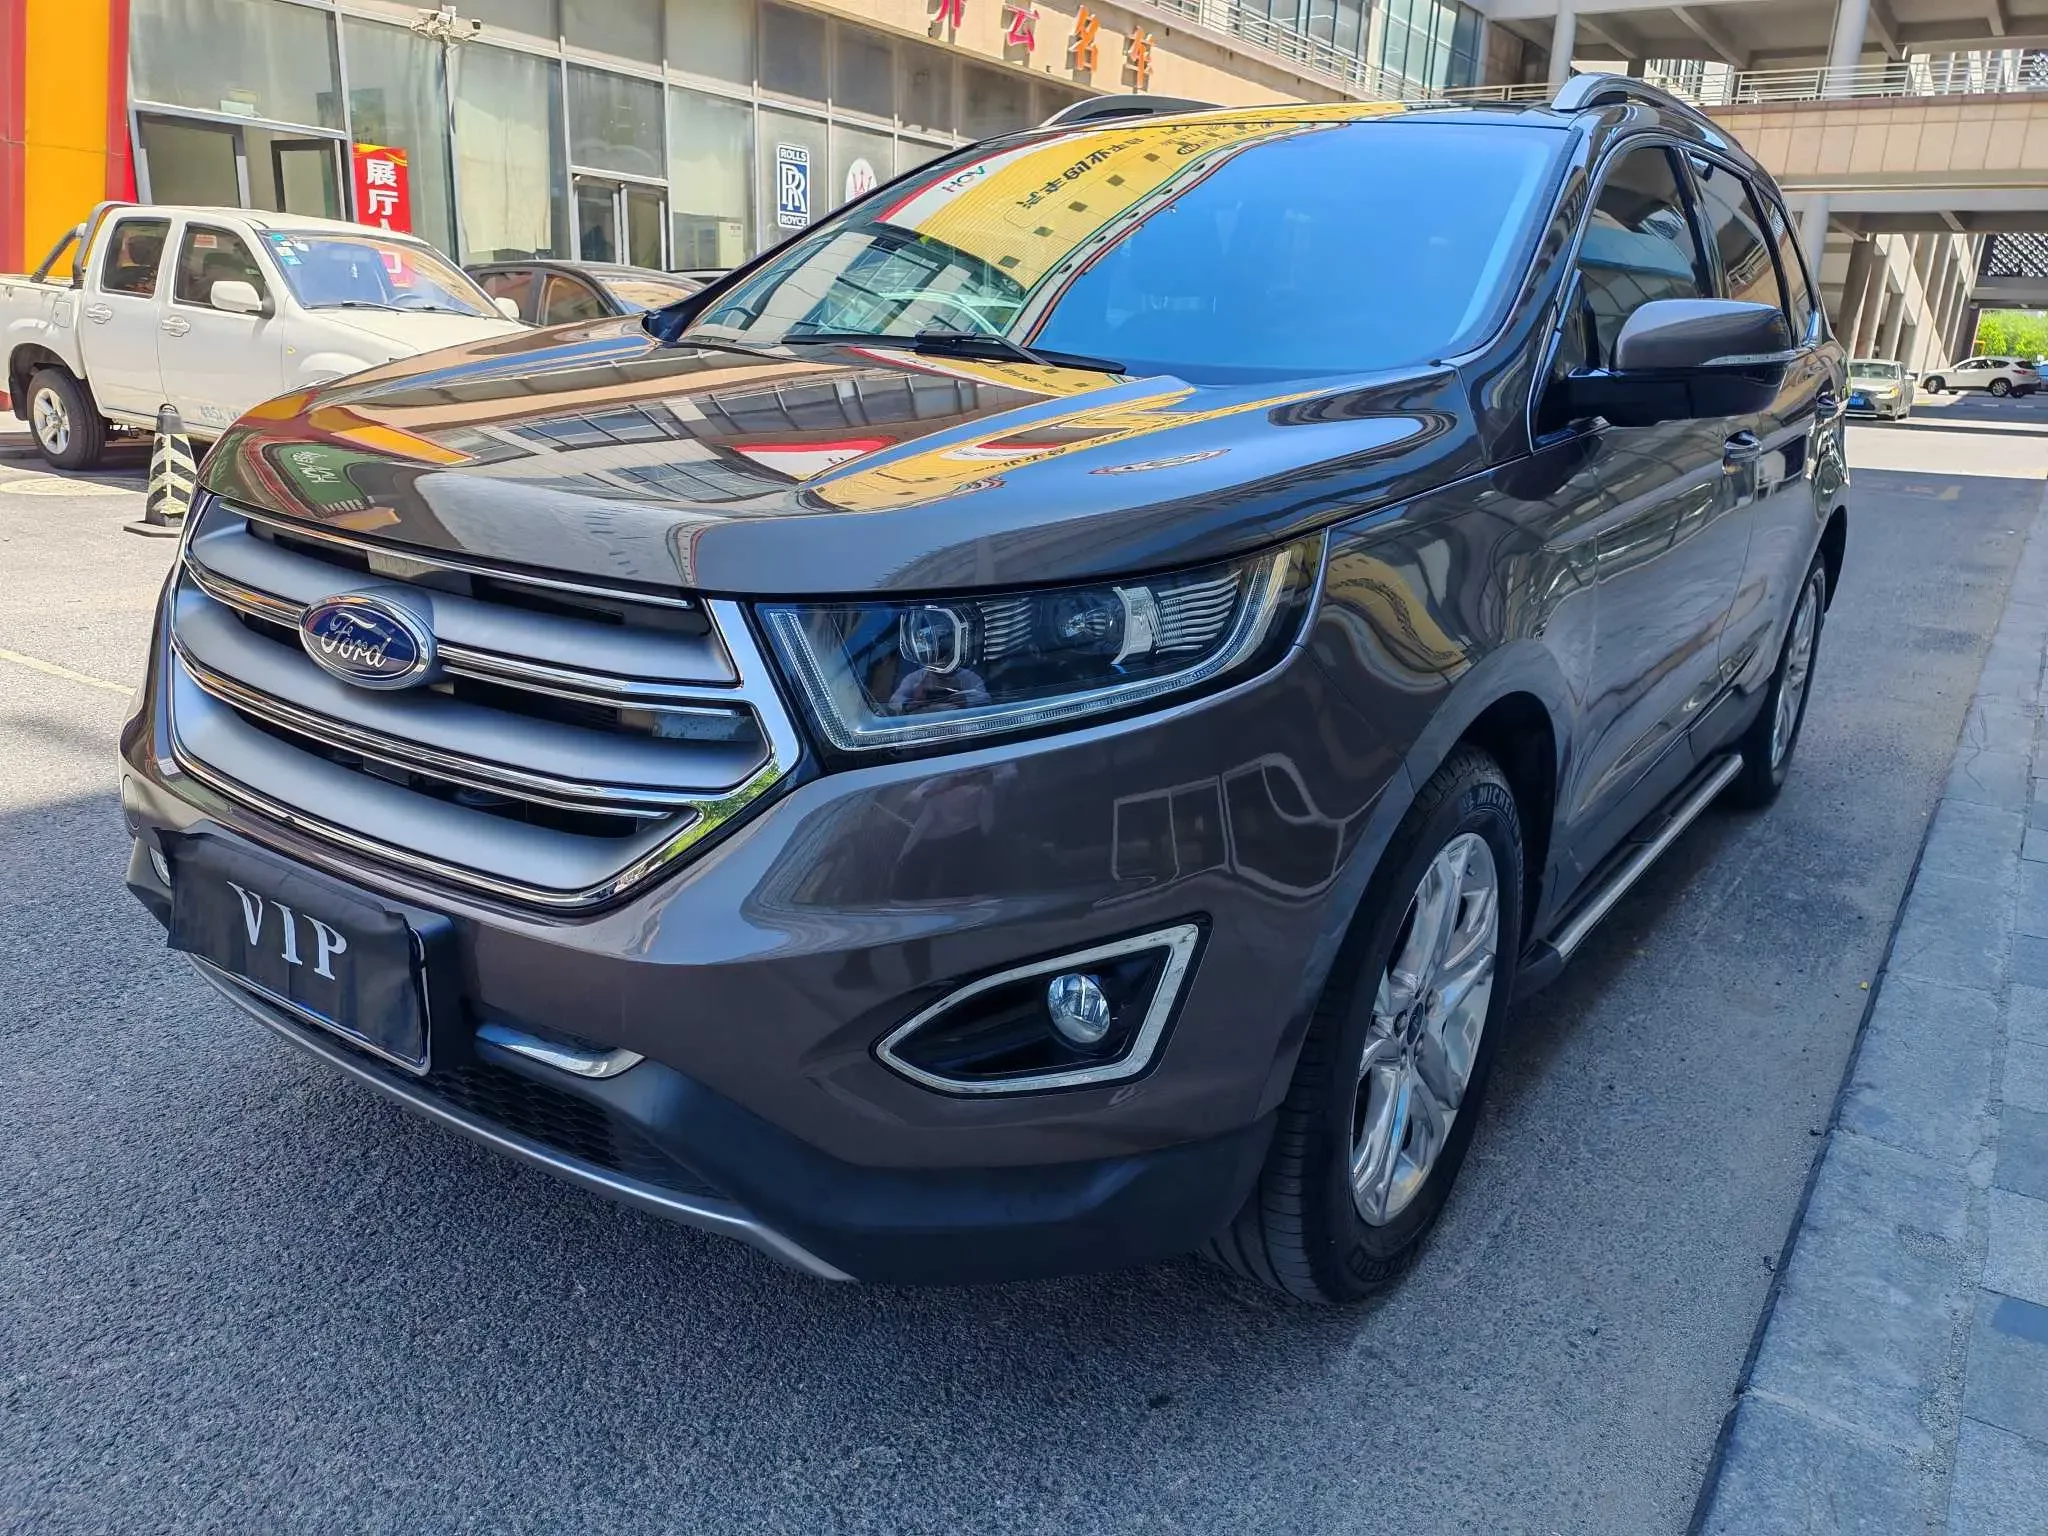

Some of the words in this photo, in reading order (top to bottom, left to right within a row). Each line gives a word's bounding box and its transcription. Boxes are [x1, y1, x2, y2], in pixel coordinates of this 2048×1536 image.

[780, 149, 806, 161] ROLLS
[781, 215, 806, 226] ROYCE
[321, 612, 392, 668] Ford
[226, 880, 347, 980] VIP
